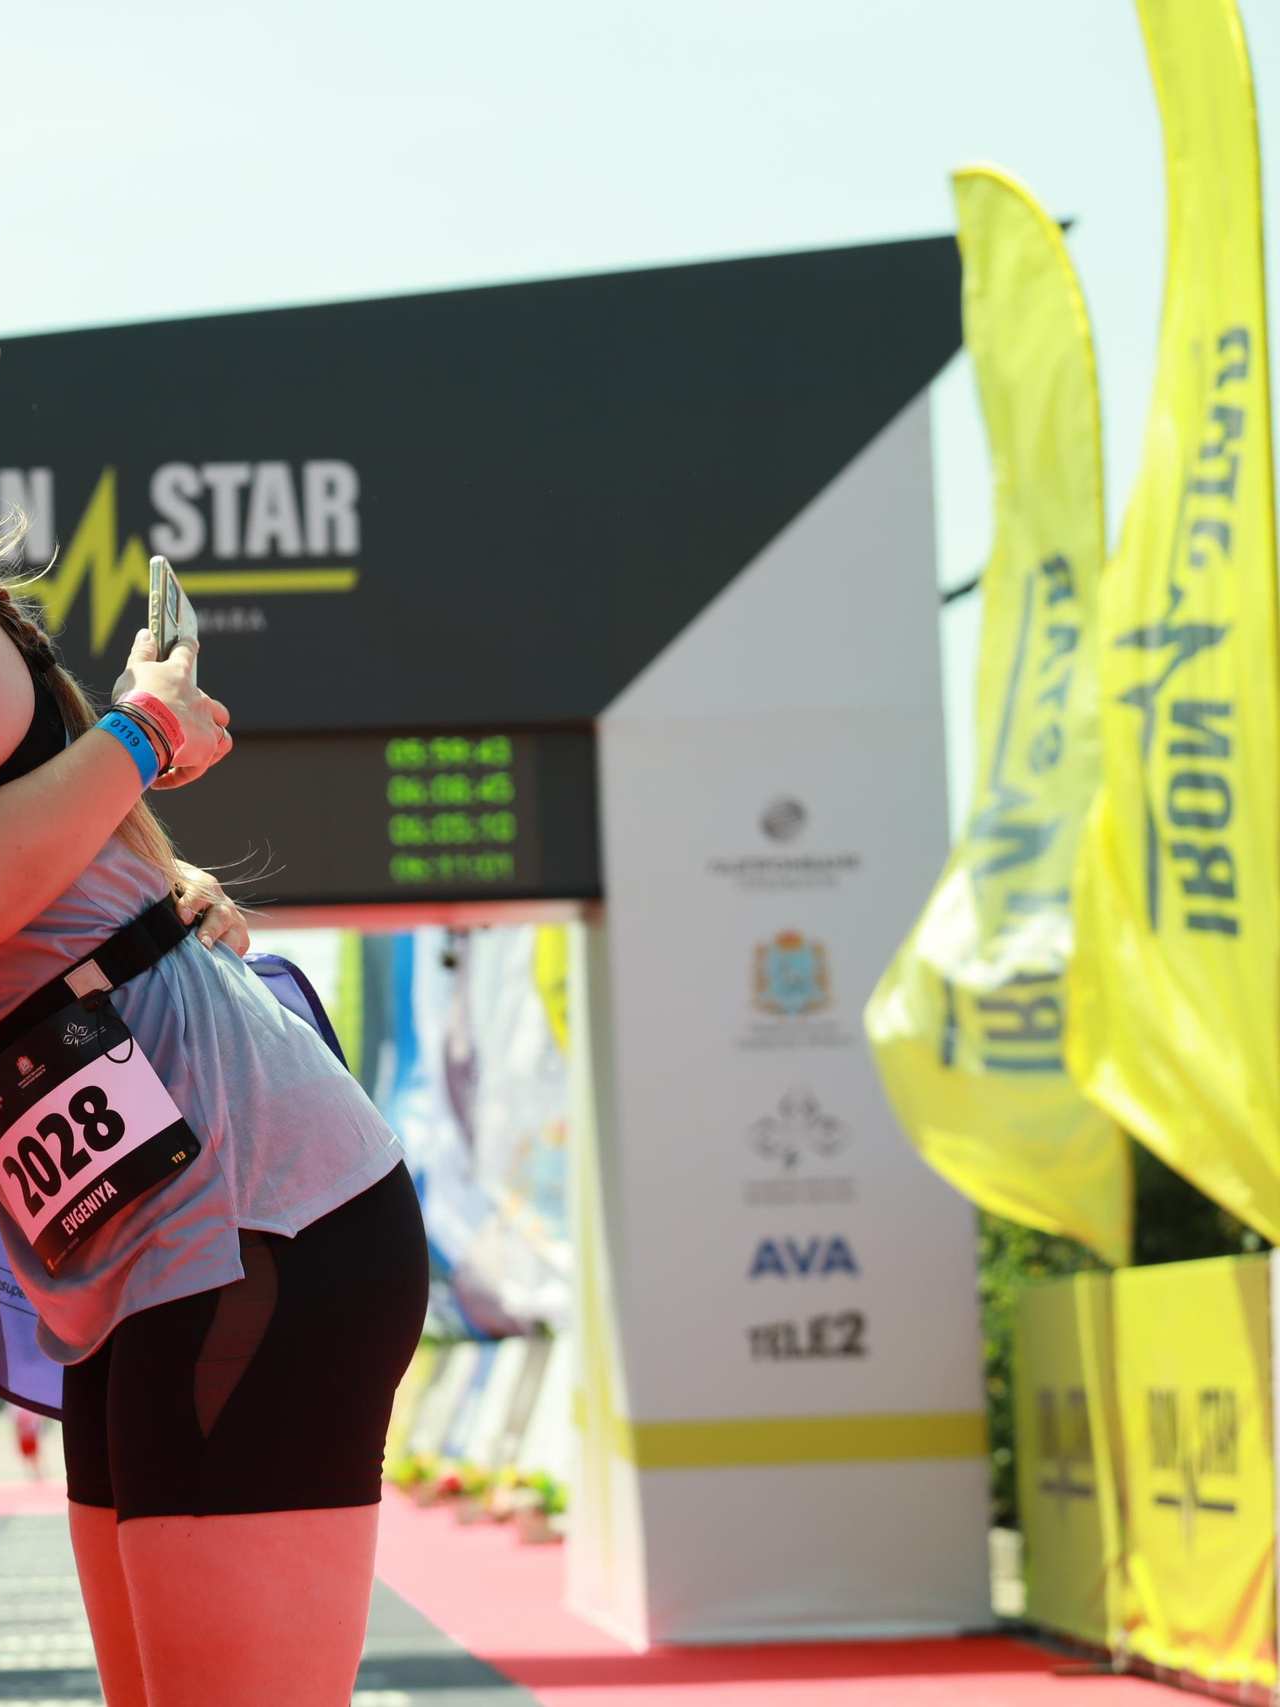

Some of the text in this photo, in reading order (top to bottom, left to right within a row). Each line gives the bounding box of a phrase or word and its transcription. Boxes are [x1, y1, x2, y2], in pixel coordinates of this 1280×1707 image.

[150, 459, 359, 563] STAR
[110, 718, 141, 747] 0119
[3, 1085, 126, 1218] 2028
[171, 1151, 186, 1164] 113
[61, 1180, 118, 1236] EVGENIYA
[749, 1235, 860, 1278] AVA
[748, 1312, 869, 1361] TELE2
